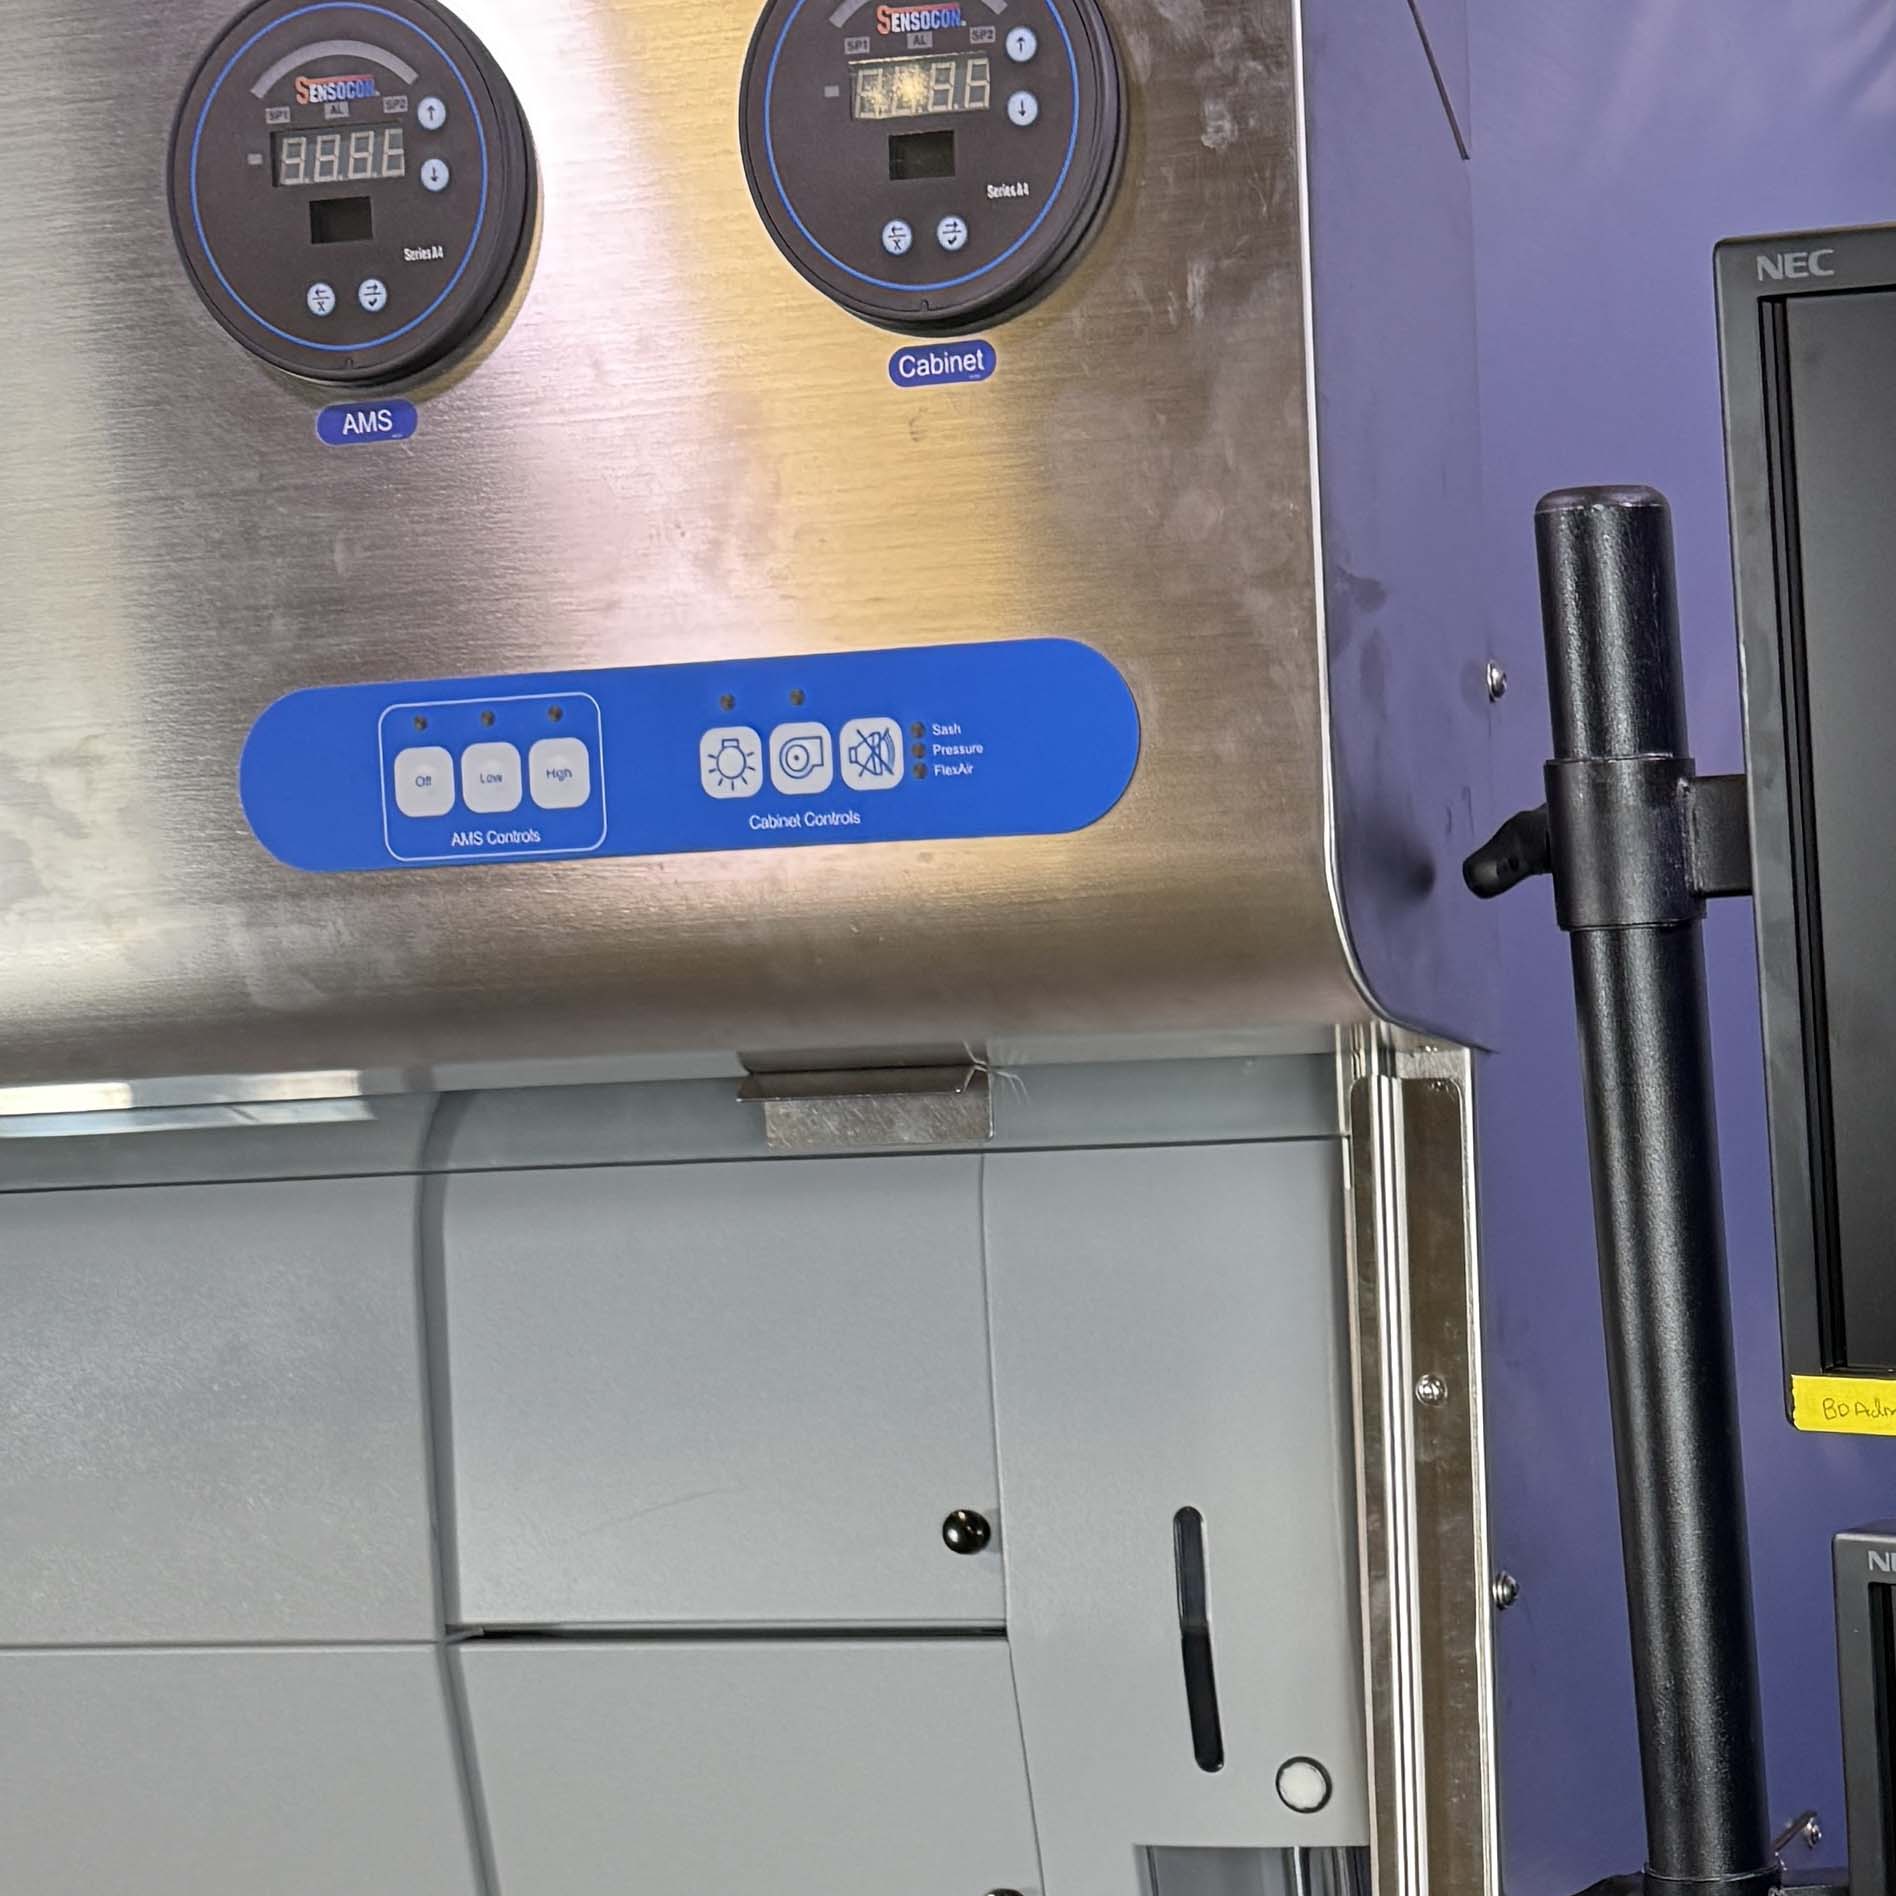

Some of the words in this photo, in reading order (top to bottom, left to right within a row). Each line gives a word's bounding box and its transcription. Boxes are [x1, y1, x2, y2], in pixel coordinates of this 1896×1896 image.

[876, 4, 962, 35] SENSOCON
[294, 75, 376, 105] SENSOCON
[1757, 249, 1835, 281] NEC
[898, 349, 985, 378] Cabinet
[342, 409, 393, 435] AMS
[932, 723, 962, 737] Sash
[932, 743, 984, 757] Pressure
[479, 773, 503, 785] Low
[546, 767, 573, 782] High
[749, 813, 801, 831] Cabinet
[803, 809, 862, 827] Controls
[451, 831, 484, 848] AMS
[486, 828, 542, 846] Controls
